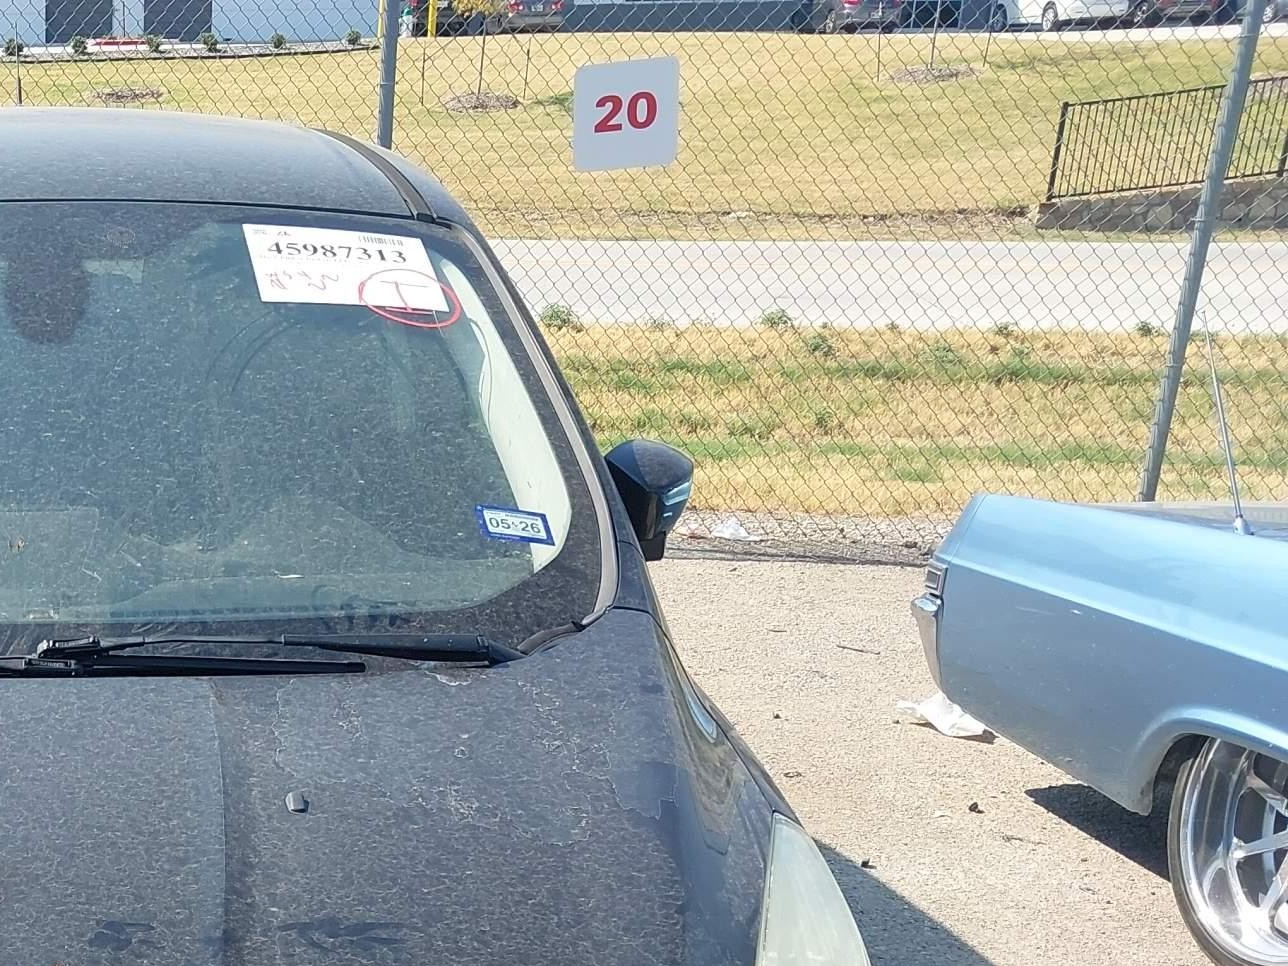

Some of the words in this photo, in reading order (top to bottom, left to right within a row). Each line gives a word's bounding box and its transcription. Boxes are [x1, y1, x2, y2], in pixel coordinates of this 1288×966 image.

[594, 91, 657, 133] 20
[267, 241, 407, 264] 45987313
[489, 517, 512, 530] 05
[519, 521, 541, 534] 26
